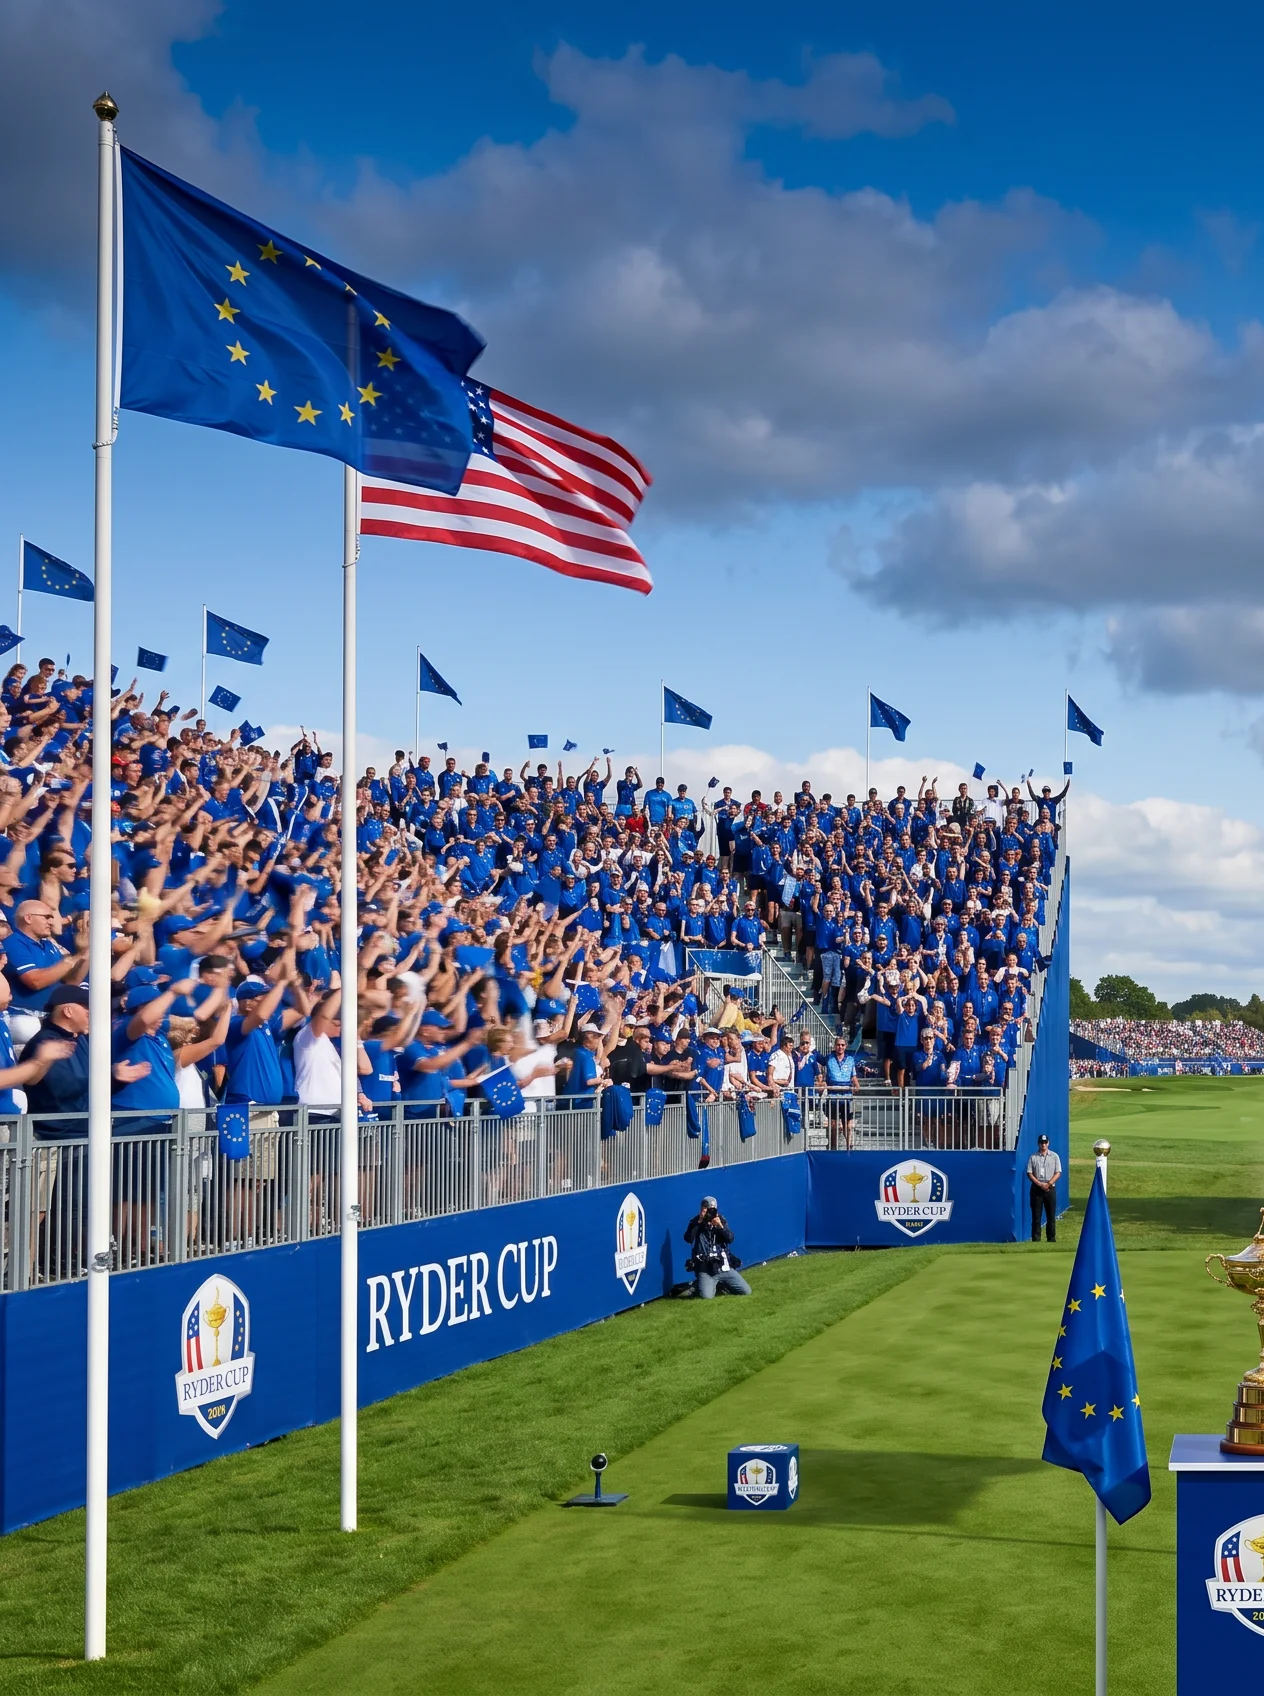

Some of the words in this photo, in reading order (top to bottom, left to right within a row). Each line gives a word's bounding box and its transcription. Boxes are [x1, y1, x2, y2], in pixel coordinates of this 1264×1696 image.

[883, 1206, 921, 1216] RYDER
[922, 1206, 947, 1216] CUP
[366, 1251, 493, 1353] RYDER
[497, 1235, 558, 1310] CUP
[183, 1373, 224, 1401] RYDER
[225, 1365, 249, 1388] CUP
